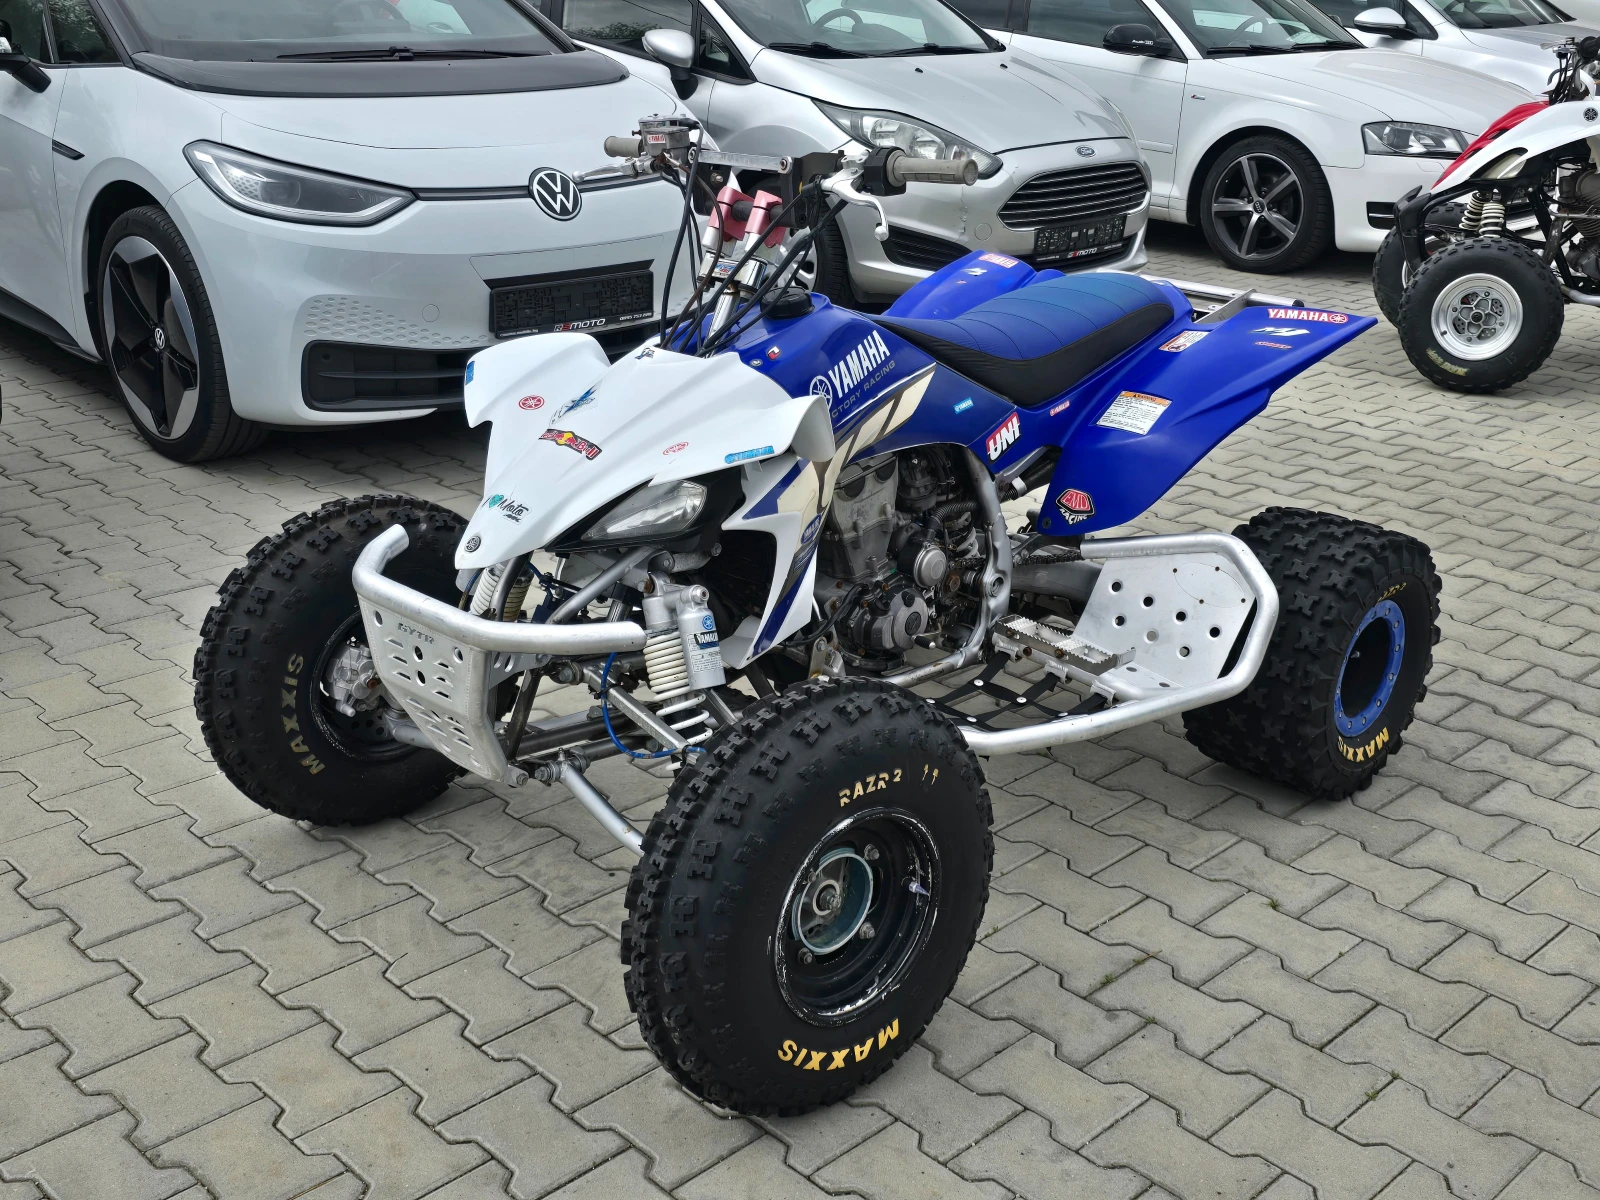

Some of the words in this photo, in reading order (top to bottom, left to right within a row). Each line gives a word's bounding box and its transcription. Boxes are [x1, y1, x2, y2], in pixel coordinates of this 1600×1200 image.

[1268, 309, 1328, 322] YAMAHA
[828, 329, 891, 399] YAMAHA
[831, 389, 861, 419] CTORY
[863, 360, 896, 392] RACING
[497, 498, 529, 516] Moto
[1059, 508, 1088, 525] RACING
[398, 622, 435, 645] GYTR
[281, 653, 326, 775] MAXXIS
[1337, 727, 1390, 763] MAXXIS
[777, 1017, 900, 1071] MAXXIS
